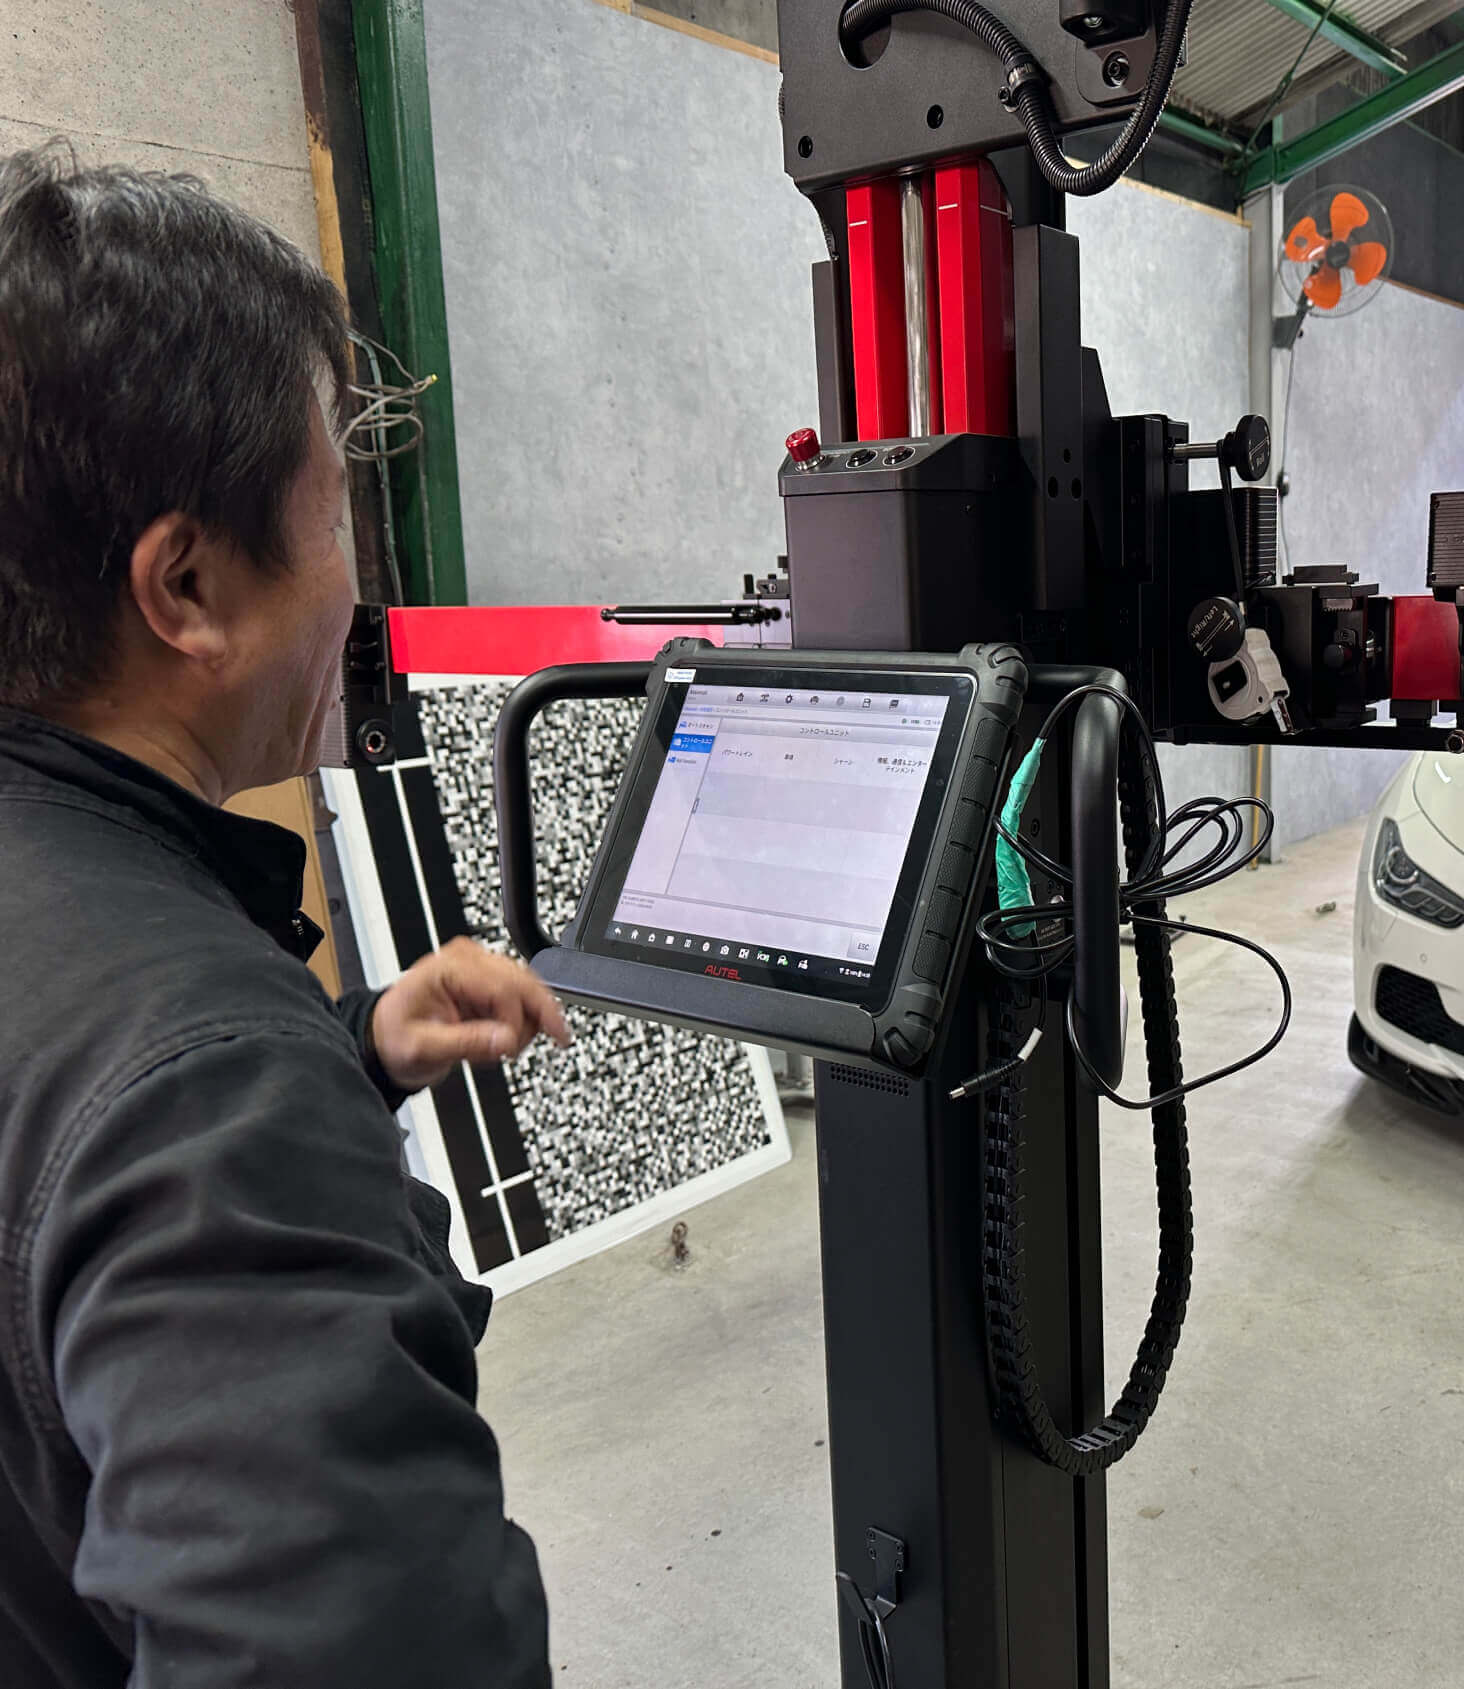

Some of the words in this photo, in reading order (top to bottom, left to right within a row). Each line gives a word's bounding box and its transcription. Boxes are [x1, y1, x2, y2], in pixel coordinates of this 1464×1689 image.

[1191, 605, 1218, 639] Left/Right
[799, 727, 850, 737] コントロールユニット
[857, 942, 870, 951] ESC
[704, 964, 744, 981] AUTEL
